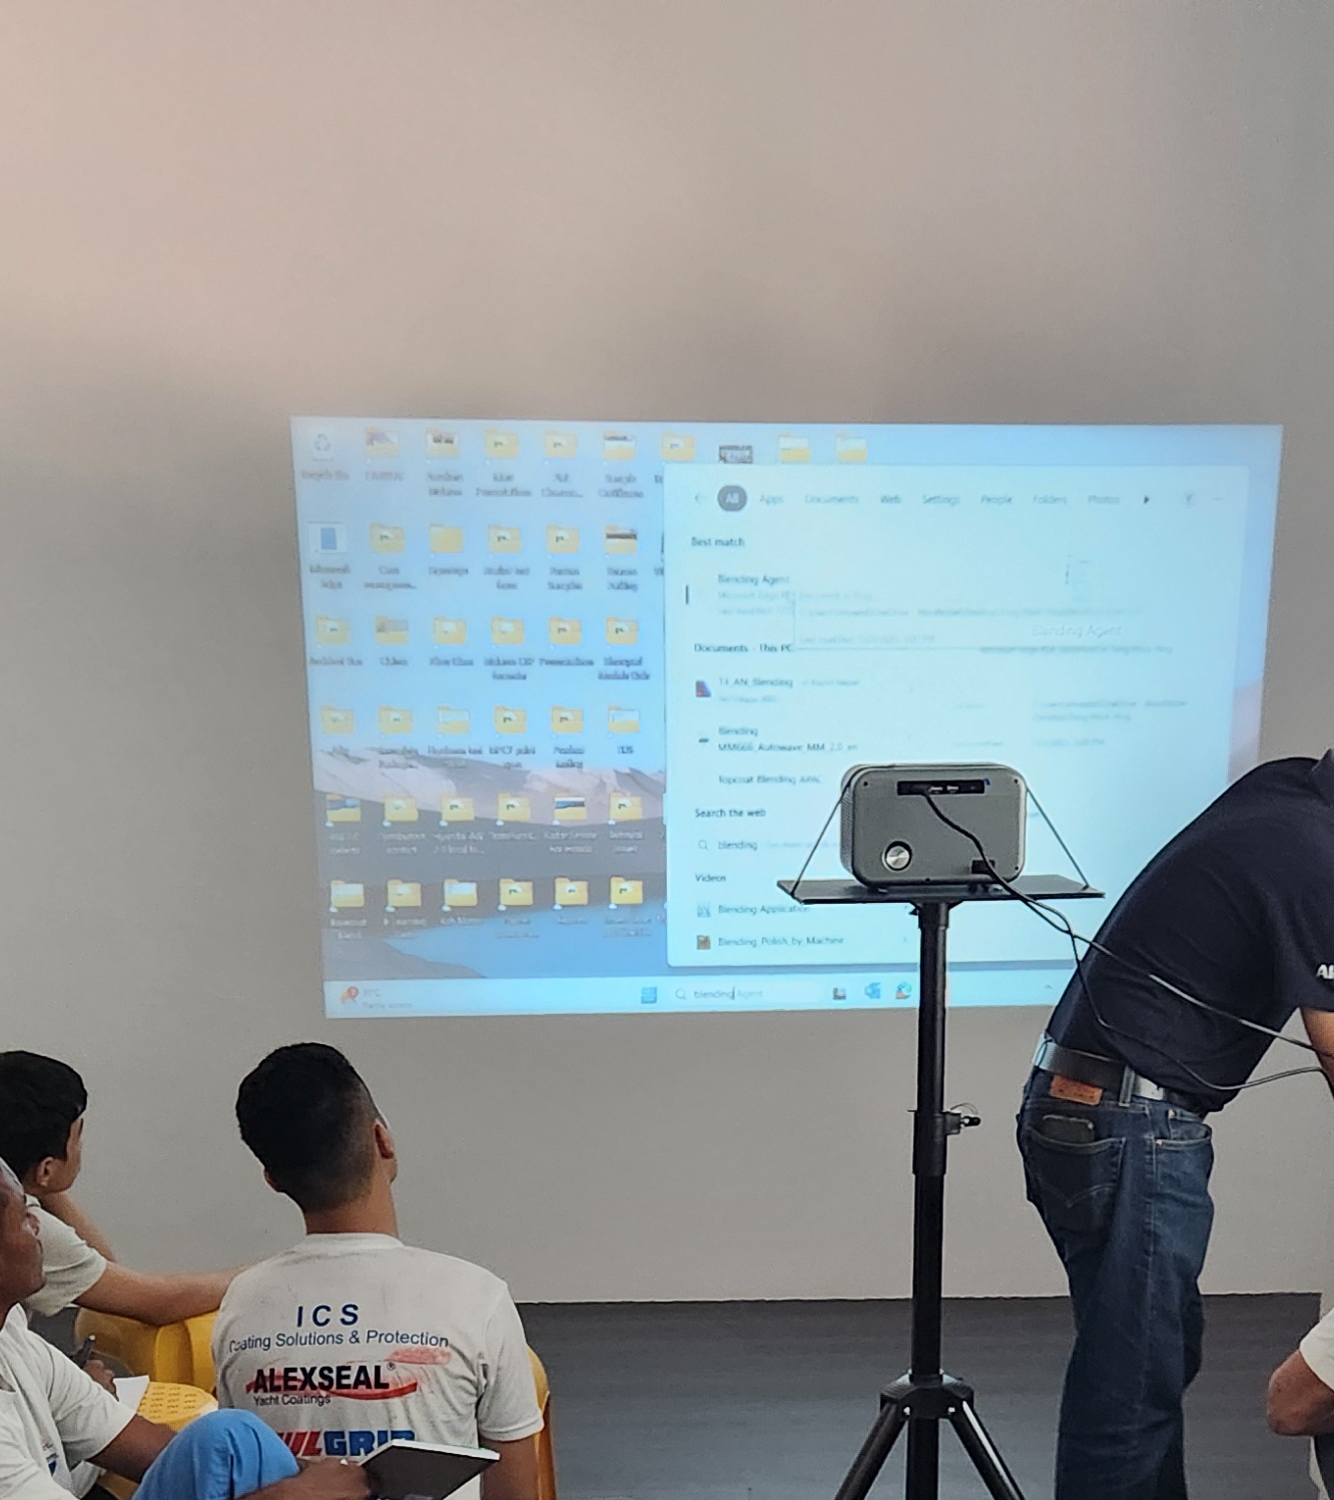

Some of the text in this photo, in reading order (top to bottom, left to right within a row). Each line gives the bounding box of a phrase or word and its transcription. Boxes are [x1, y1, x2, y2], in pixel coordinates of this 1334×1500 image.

[691, 536, 746, 548] Best match
[718, 573, 759, 586] Blending
[694, 642, 749, 653] Documents
[759, 642, 779, 653] This
[718, 725, 758, 737] Blending
[756, 774, 797, 786] Blending
[695, 807, 767, 818] Search the web
[718, 840, 758, 851] blending
[695, 872, 727, 883] Videos
[275, 1331, 344, 1347] Solutions
[348, 1330, 360, 1344] &
[367, 1329, 449, 1348] Protection
[253, 1364, 390, 1393] ALEXSEAL
[253, 1393, 331, 1407] Yacht Coatings
